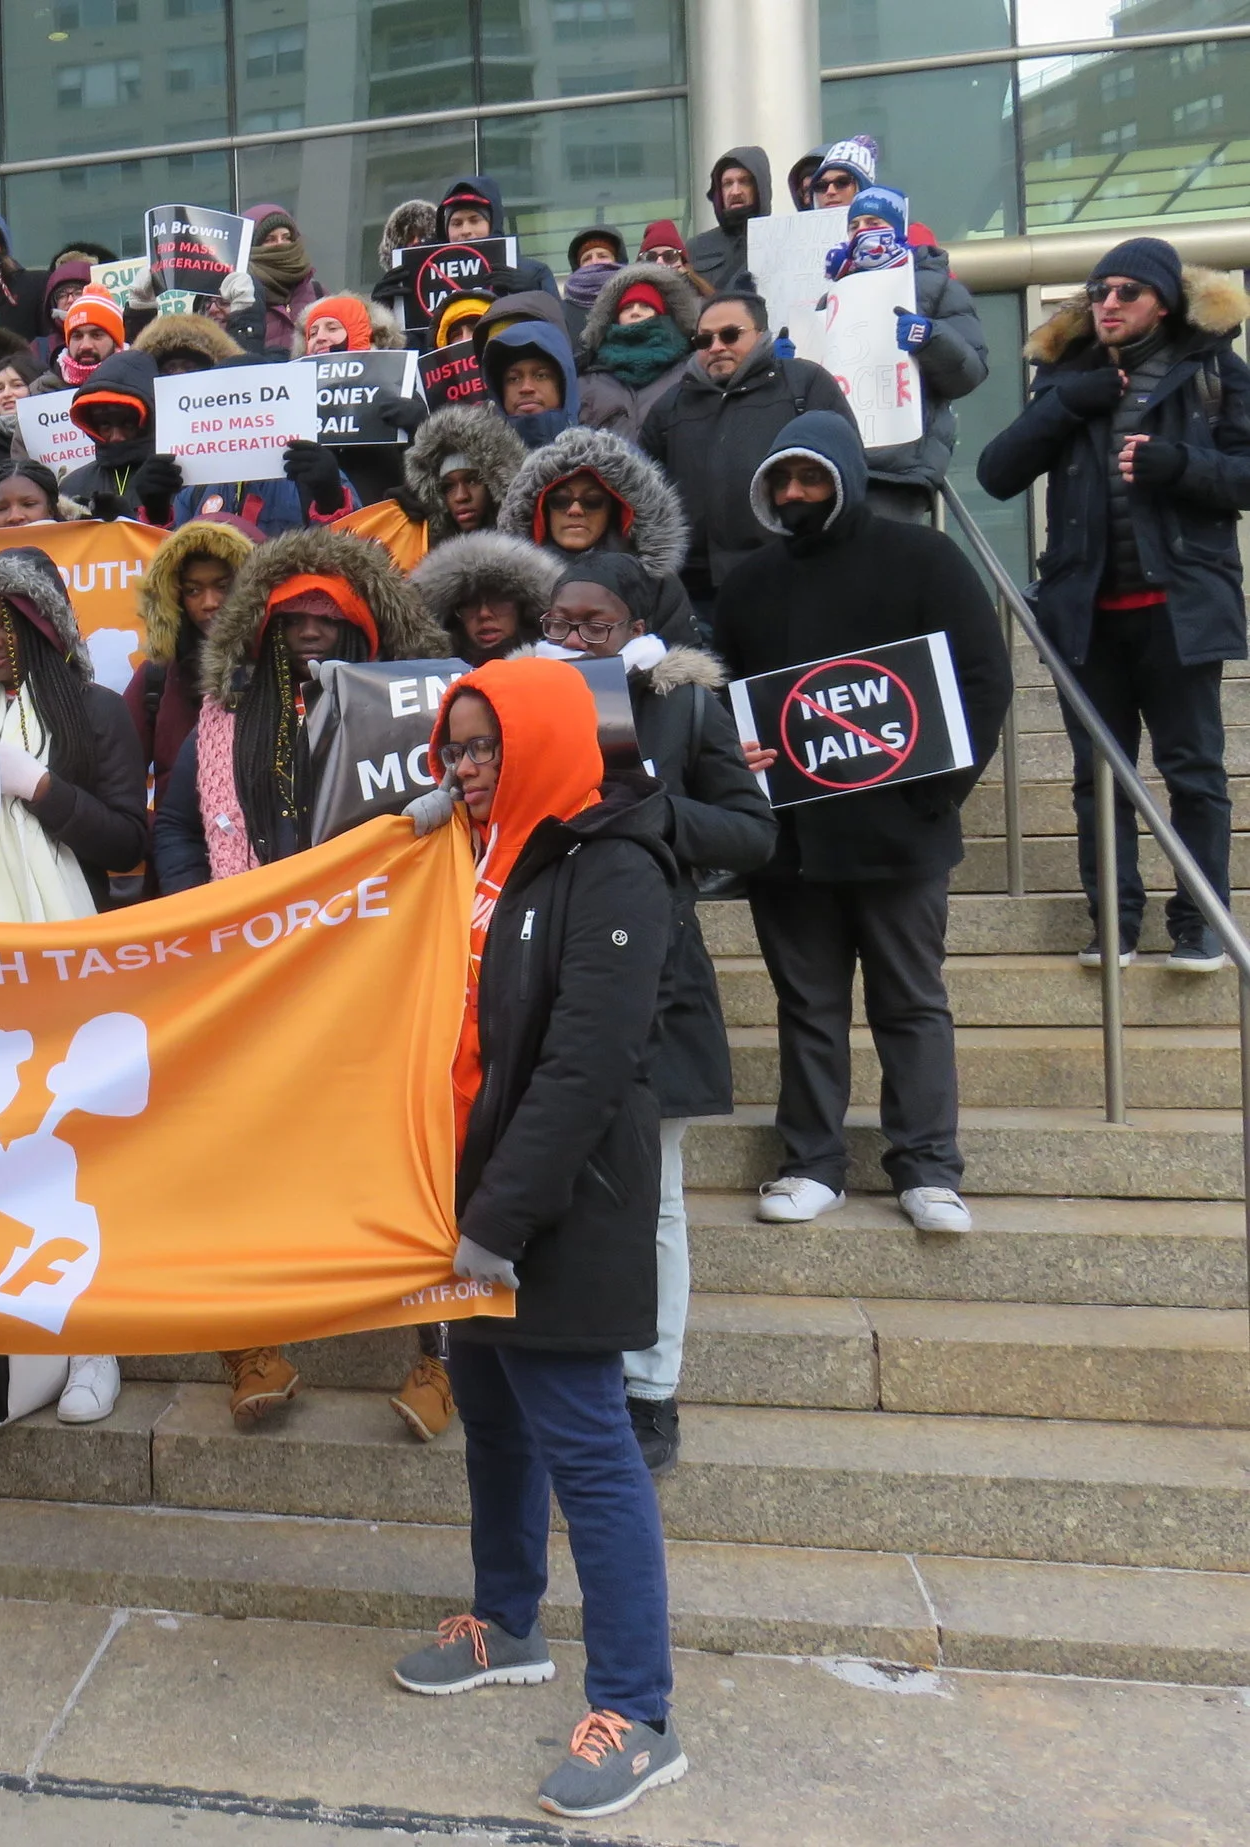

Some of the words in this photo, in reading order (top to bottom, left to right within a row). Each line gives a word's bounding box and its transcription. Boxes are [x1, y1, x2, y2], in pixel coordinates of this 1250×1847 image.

[152, 223, 166, 238] DA
[170, 220, 230, 241] Brown:
[157, 242, 176, 255] END
[179, 241, 217, 256] MASS
[430, 258, 482, 280] NEW
[317, 361, 365, 380] END
[178, 390, 253, 412] Queens
[259, 385, 291, 402] DA
[315, 386, 381, 407] ONEY
[191, 418, 224, 434] END
[229, 414, 276, 430] MASS
[52, 430, 78, 445] END
[169, 433, 301, 458] INCARCERATION
[800, 675, 890, 721] NEW
[803, 721, 906, 773] JAILS
[42, 935, 195, 982] TASK
[210, 874, 391, 954] FORCE
